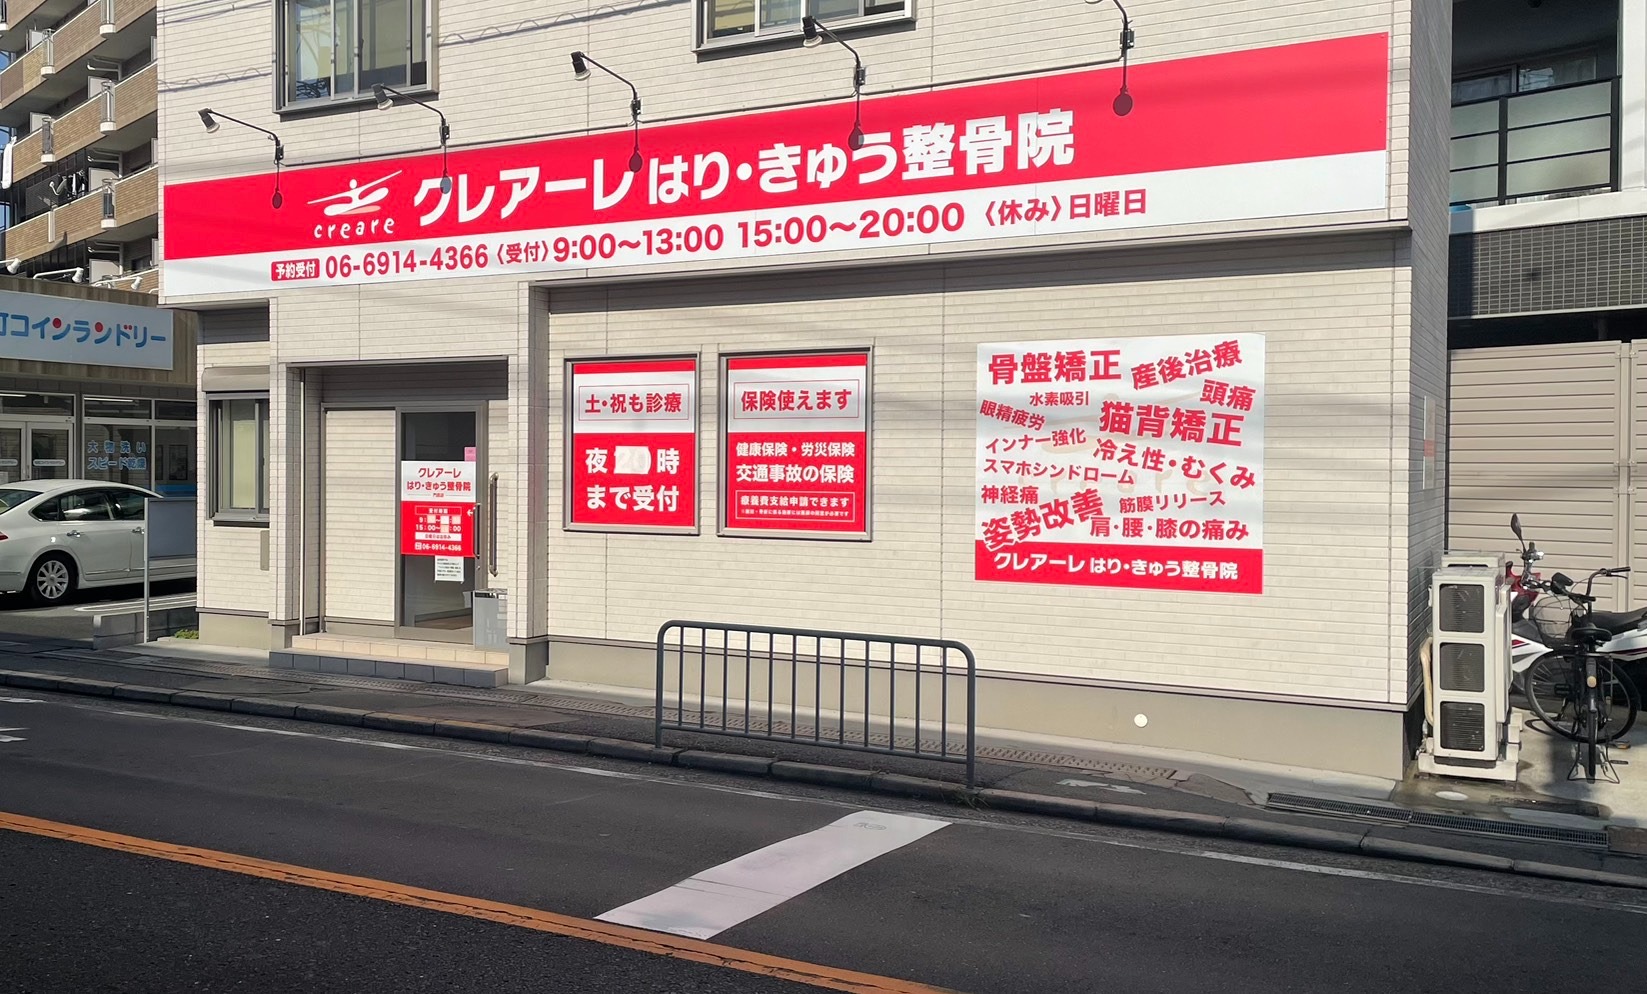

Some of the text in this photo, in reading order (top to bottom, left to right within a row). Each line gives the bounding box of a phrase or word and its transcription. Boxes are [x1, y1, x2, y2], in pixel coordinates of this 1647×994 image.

[413, 107, 1075, 227] クレアーレ はり・きゅう整骨院
[275, 260, 316, 280] 予約受付
[325, 244, 488, 278] 06-6914-4366
[1068, 188, 1147, 220] 日曜日
[314, 218, 395, 239] creare
[988, 349, 1123, 385] 骨盤矯正
[1130, 340, 1242, 390] 産後治療
[584, 392, 682, 414] 土・祝も診療
[740, 389, 852, 412] 保険使えます
[1029, 391, 1090, 407] 水素吸引
[1199, 379, 1256, 412] 頭痛
[980, 399, 1046, 431] 眼精疲労
[1099, 400, 1246, 447] 猫背矯正
[735, 441, 856, 458] 健康保険・労災保険
[985, 428, 1086, 454] インナー強化
[418, 468, 461, 478] クレアーレ
[735, 464, 855, 483] 交通事故の保険
[983, 458, 1135, 485] スマホシンドローム
[1092, 438, 1256, 489] 冷え性・むくみ
[586, 484, 679, 512] まで受付
[980, 484, 1039, 505] 神経痛
[1119, 490, 1226, 514] 筋膜リリース
[981, 488, 1104, 549] 姿勢改善
[1090, 516, 1249, 541] 肩・腰・膝の痛み
[993, 553, 1239, 580] クレアーレ はり・きゅう整骨院
